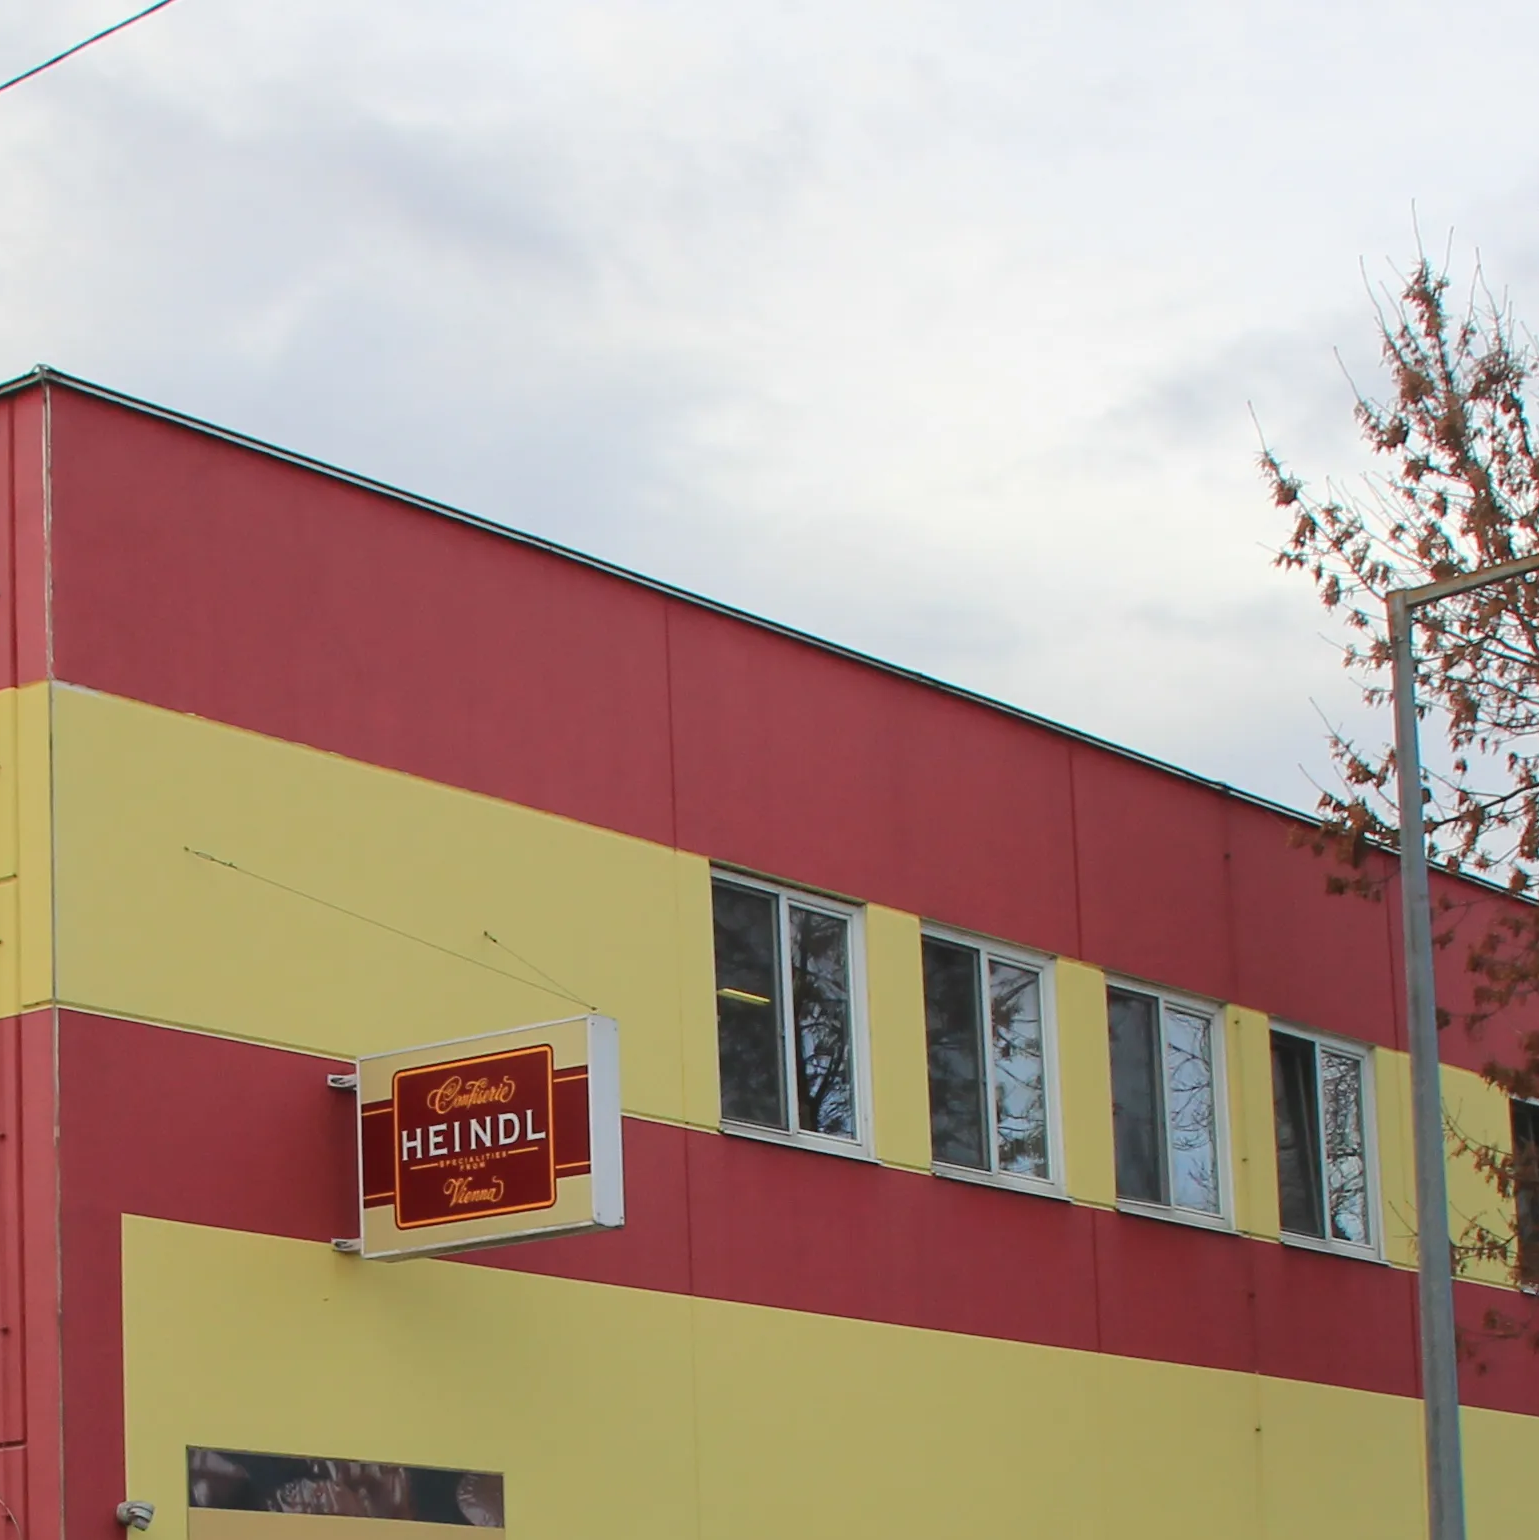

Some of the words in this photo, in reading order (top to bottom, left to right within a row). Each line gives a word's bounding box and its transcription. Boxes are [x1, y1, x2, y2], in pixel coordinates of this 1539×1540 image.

[427, 1075, 516, 1115] Confiserie
[401, 1108, 547, 1162] HEINDL
[439, 1150, 507, 1169] SPECIALITIES
[459, 1161, 486, 1171] FROM
[443, 1175, 504, 1208] Vienna
